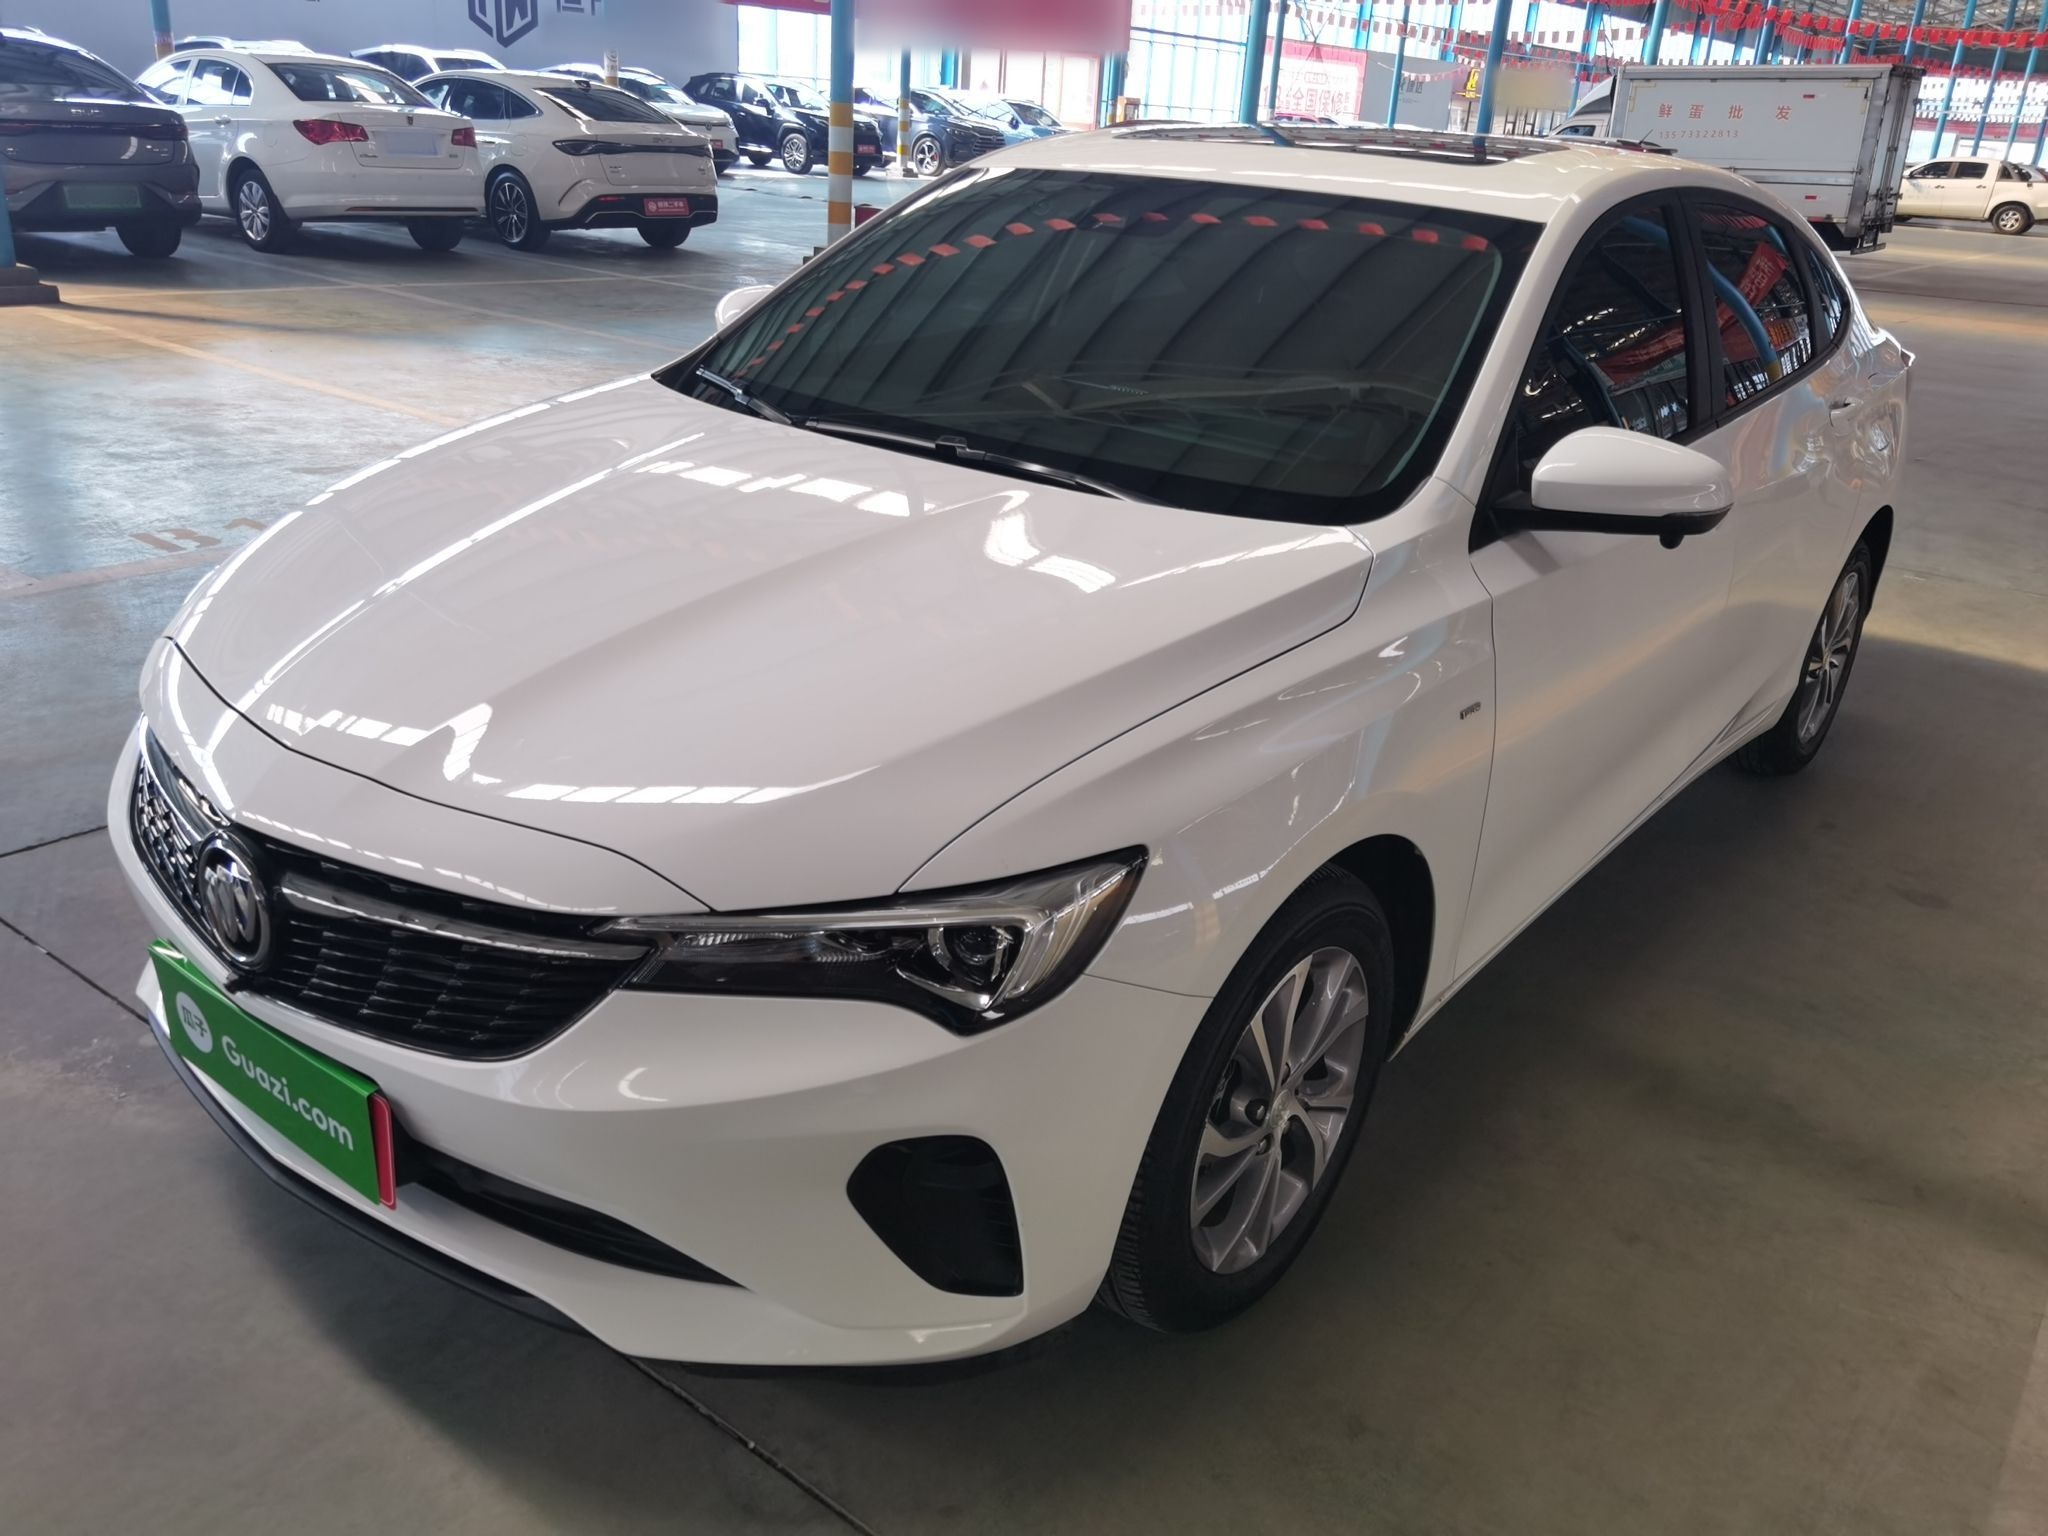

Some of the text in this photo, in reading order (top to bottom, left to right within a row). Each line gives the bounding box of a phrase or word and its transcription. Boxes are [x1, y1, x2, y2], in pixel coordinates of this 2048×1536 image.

[1658, 103, 1792, 121] 鲜蛋批发
[1659, 129, 1739, 139] 13573322813
[181, 1005, 208, 1038] 瓜子
[221, 1035, 353, 1151] Guazi.com
